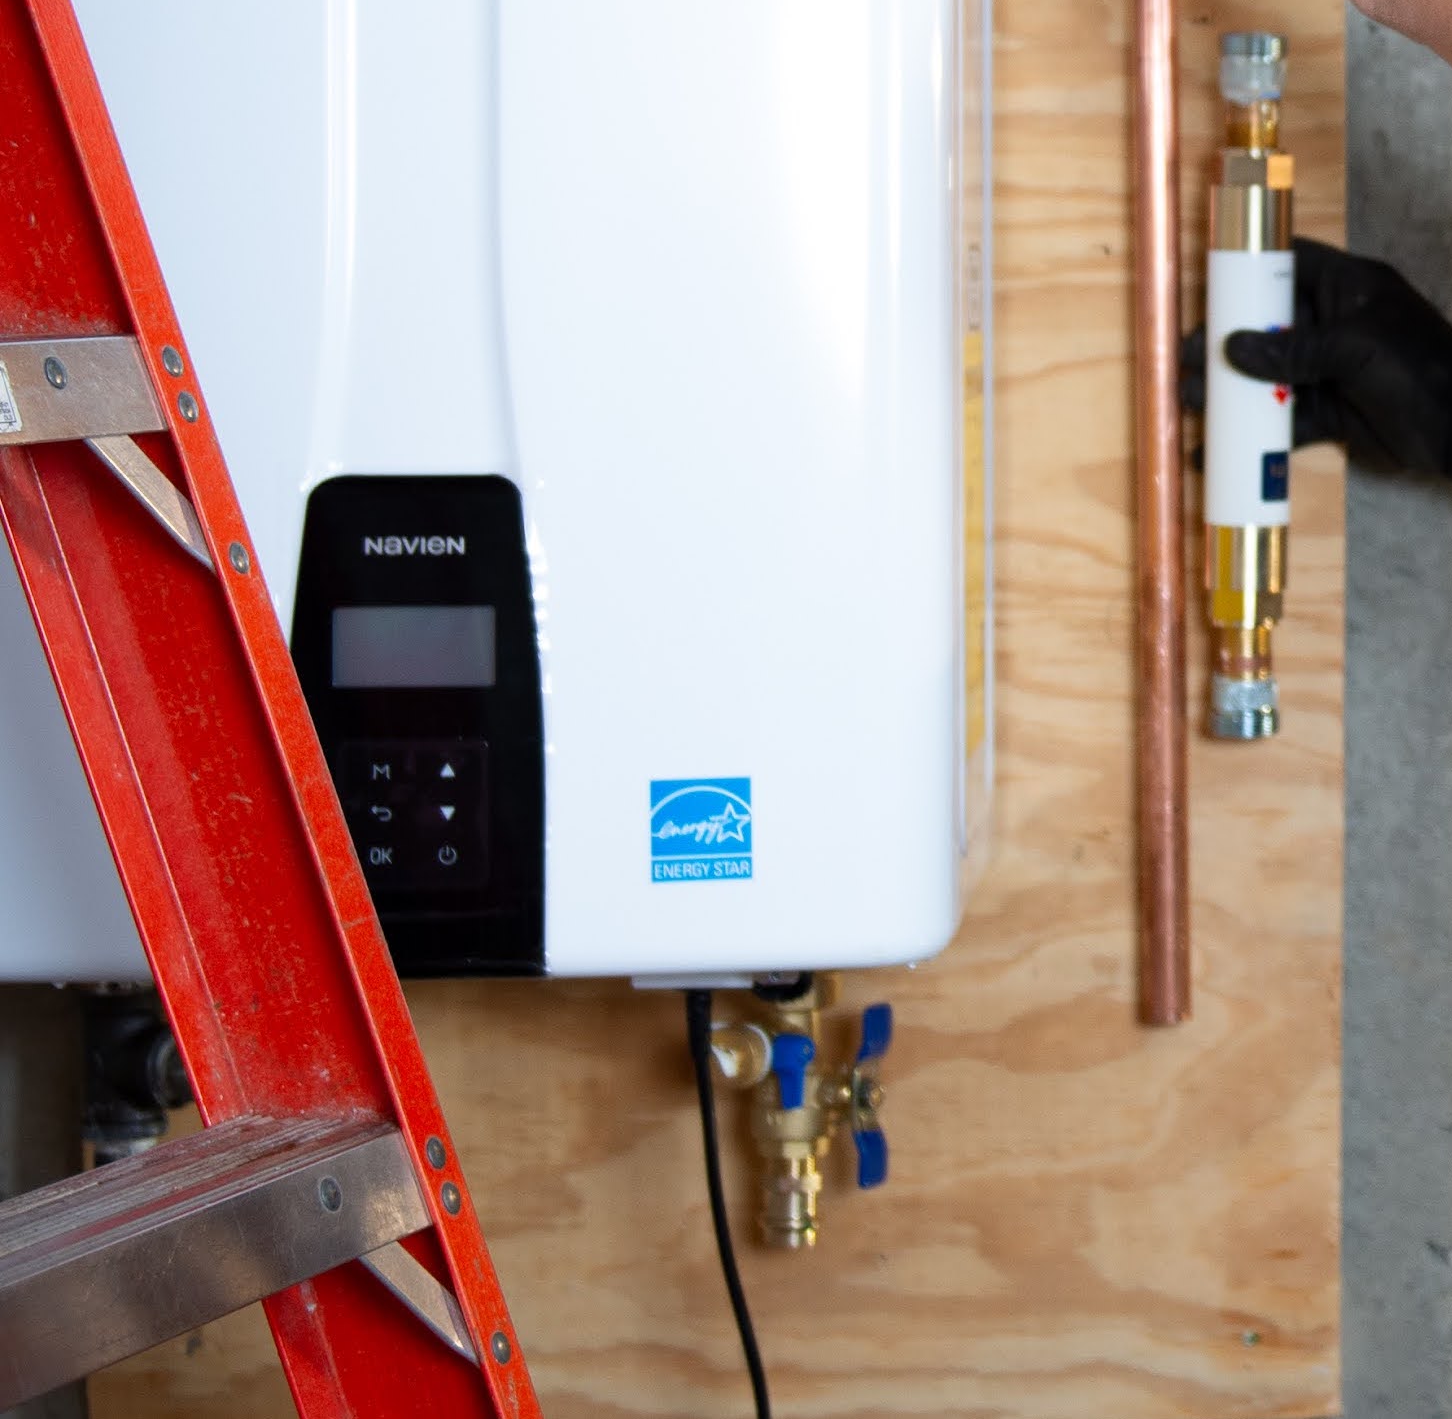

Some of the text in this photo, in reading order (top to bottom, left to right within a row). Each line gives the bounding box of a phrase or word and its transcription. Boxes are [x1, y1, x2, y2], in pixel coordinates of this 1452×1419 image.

[372, 764, 391, 781] M
[370, 846, 393, 865] OK
[654, 860, 750, 879] ENERGY STAR
